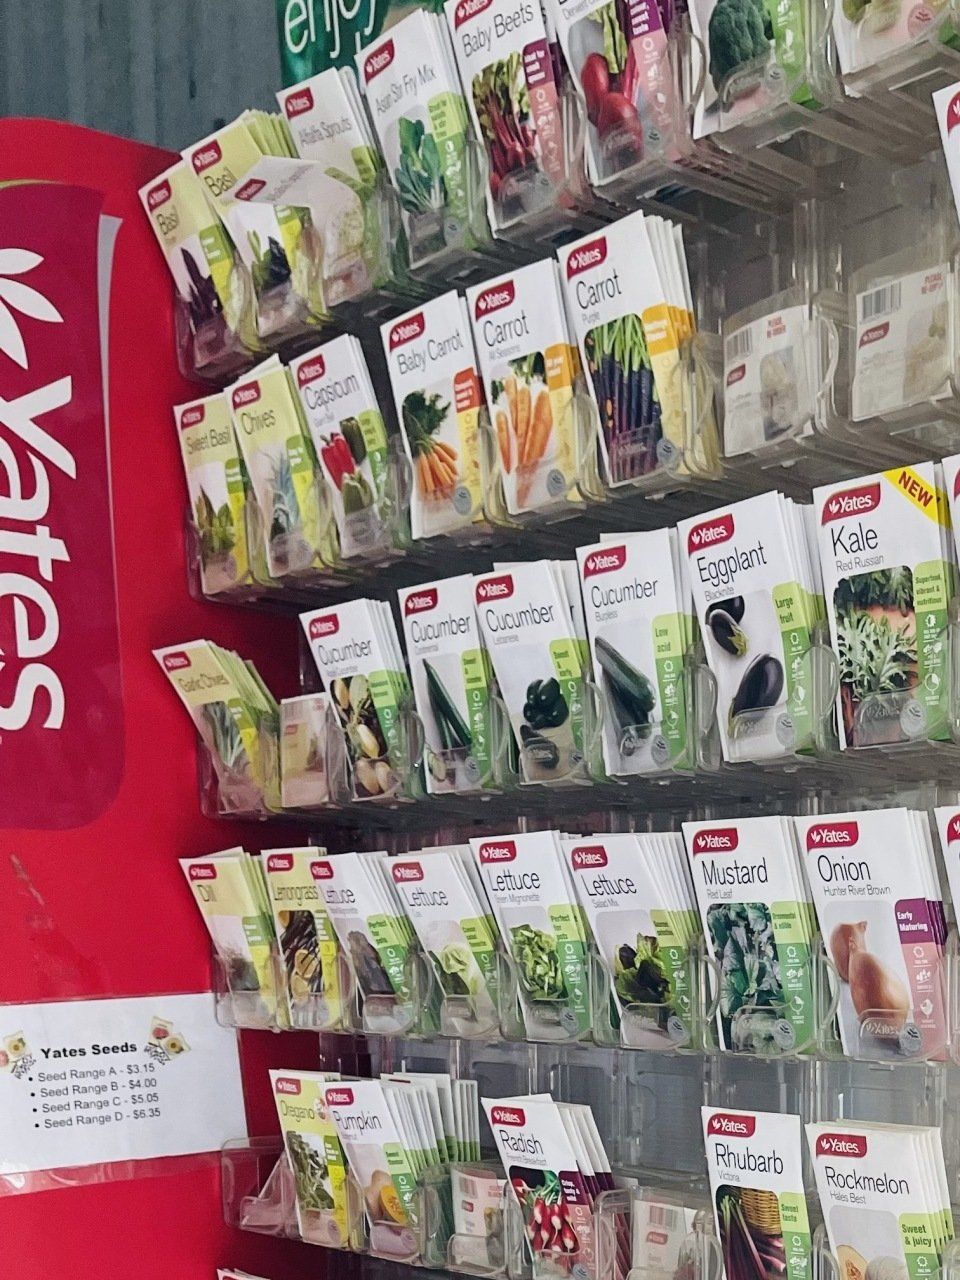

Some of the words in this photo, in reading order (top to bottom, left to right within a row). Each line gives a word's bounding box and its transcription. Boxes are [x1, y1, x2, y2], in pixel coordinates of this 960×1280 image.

[461, 25, 492, 58] Baby
[493, 4, 534, 36] Beets
[418, 65, 436, 90] Mix
[576, 271, 622, 309] Carrot
[483, 316, 530, 347] Carrot
[398, 352, 426, 374] Baby
[428, 332, 464, 362] Carrot
[305, 373, 359, 411] Capsicum
[241, 409, 276, 436] Chives
[210, 425, 230, 448] Basil
[899, 469, 934, 507] NEW
[832, 522, 878, 555] Kale
[697, 540, 767, 587] Eggplant
[591, 577, 659, 609] Cucumber
[411, 614, 471, 645] Cucumber
[486, 603, 555, 632] Cucumber
[318, 638, 373, 665] Cucumber
[489, 870, 540, 892] Lettuce
[702, 859, 768, 885] Mustard
[817, 854, 870, 882] Onion
[275, 883, 318, 906] Lemongrass
[407, 887, 448, 908] Lettuce
[583, 875, 637, 897] Lettuce
[41, 1046, 87, 1059] Yates
[92, 1041, 137, 1055] Seeds
[38, 1071, 67, 1082] Seed
[70, 1068, 105, 1081] Range
[109, 1066, 117, 1076] A
[126, 1062, 155, 1076] $3.15
[40, 1086, 69, 1098] Seed
[72, 1083, 108, 1097] Range
[111, 1081, 118, 1091] B
[129, 1077, 157, 1090] $4.00
[42, 1101, 71, 1113] Seed
[74, 1098, 109, 1112] Range
[112, 1096, 121, 1106] C
[131, 1092, 159, 1105] $5.05
[44, 1117, 73, 1129] Seed
[76, 1113, 111, 1128] Range
[114, 1111, 123, 1122] D
[133, 1107, 161, 1120] $6.35
[334, 1110, 382, 1134] Pumpkin
[501, 1129, 544, 1155] Radish
[715, 1143, 784, 1174] Rhubarb
[825, 1165, 910, 1195] Rockmelon
